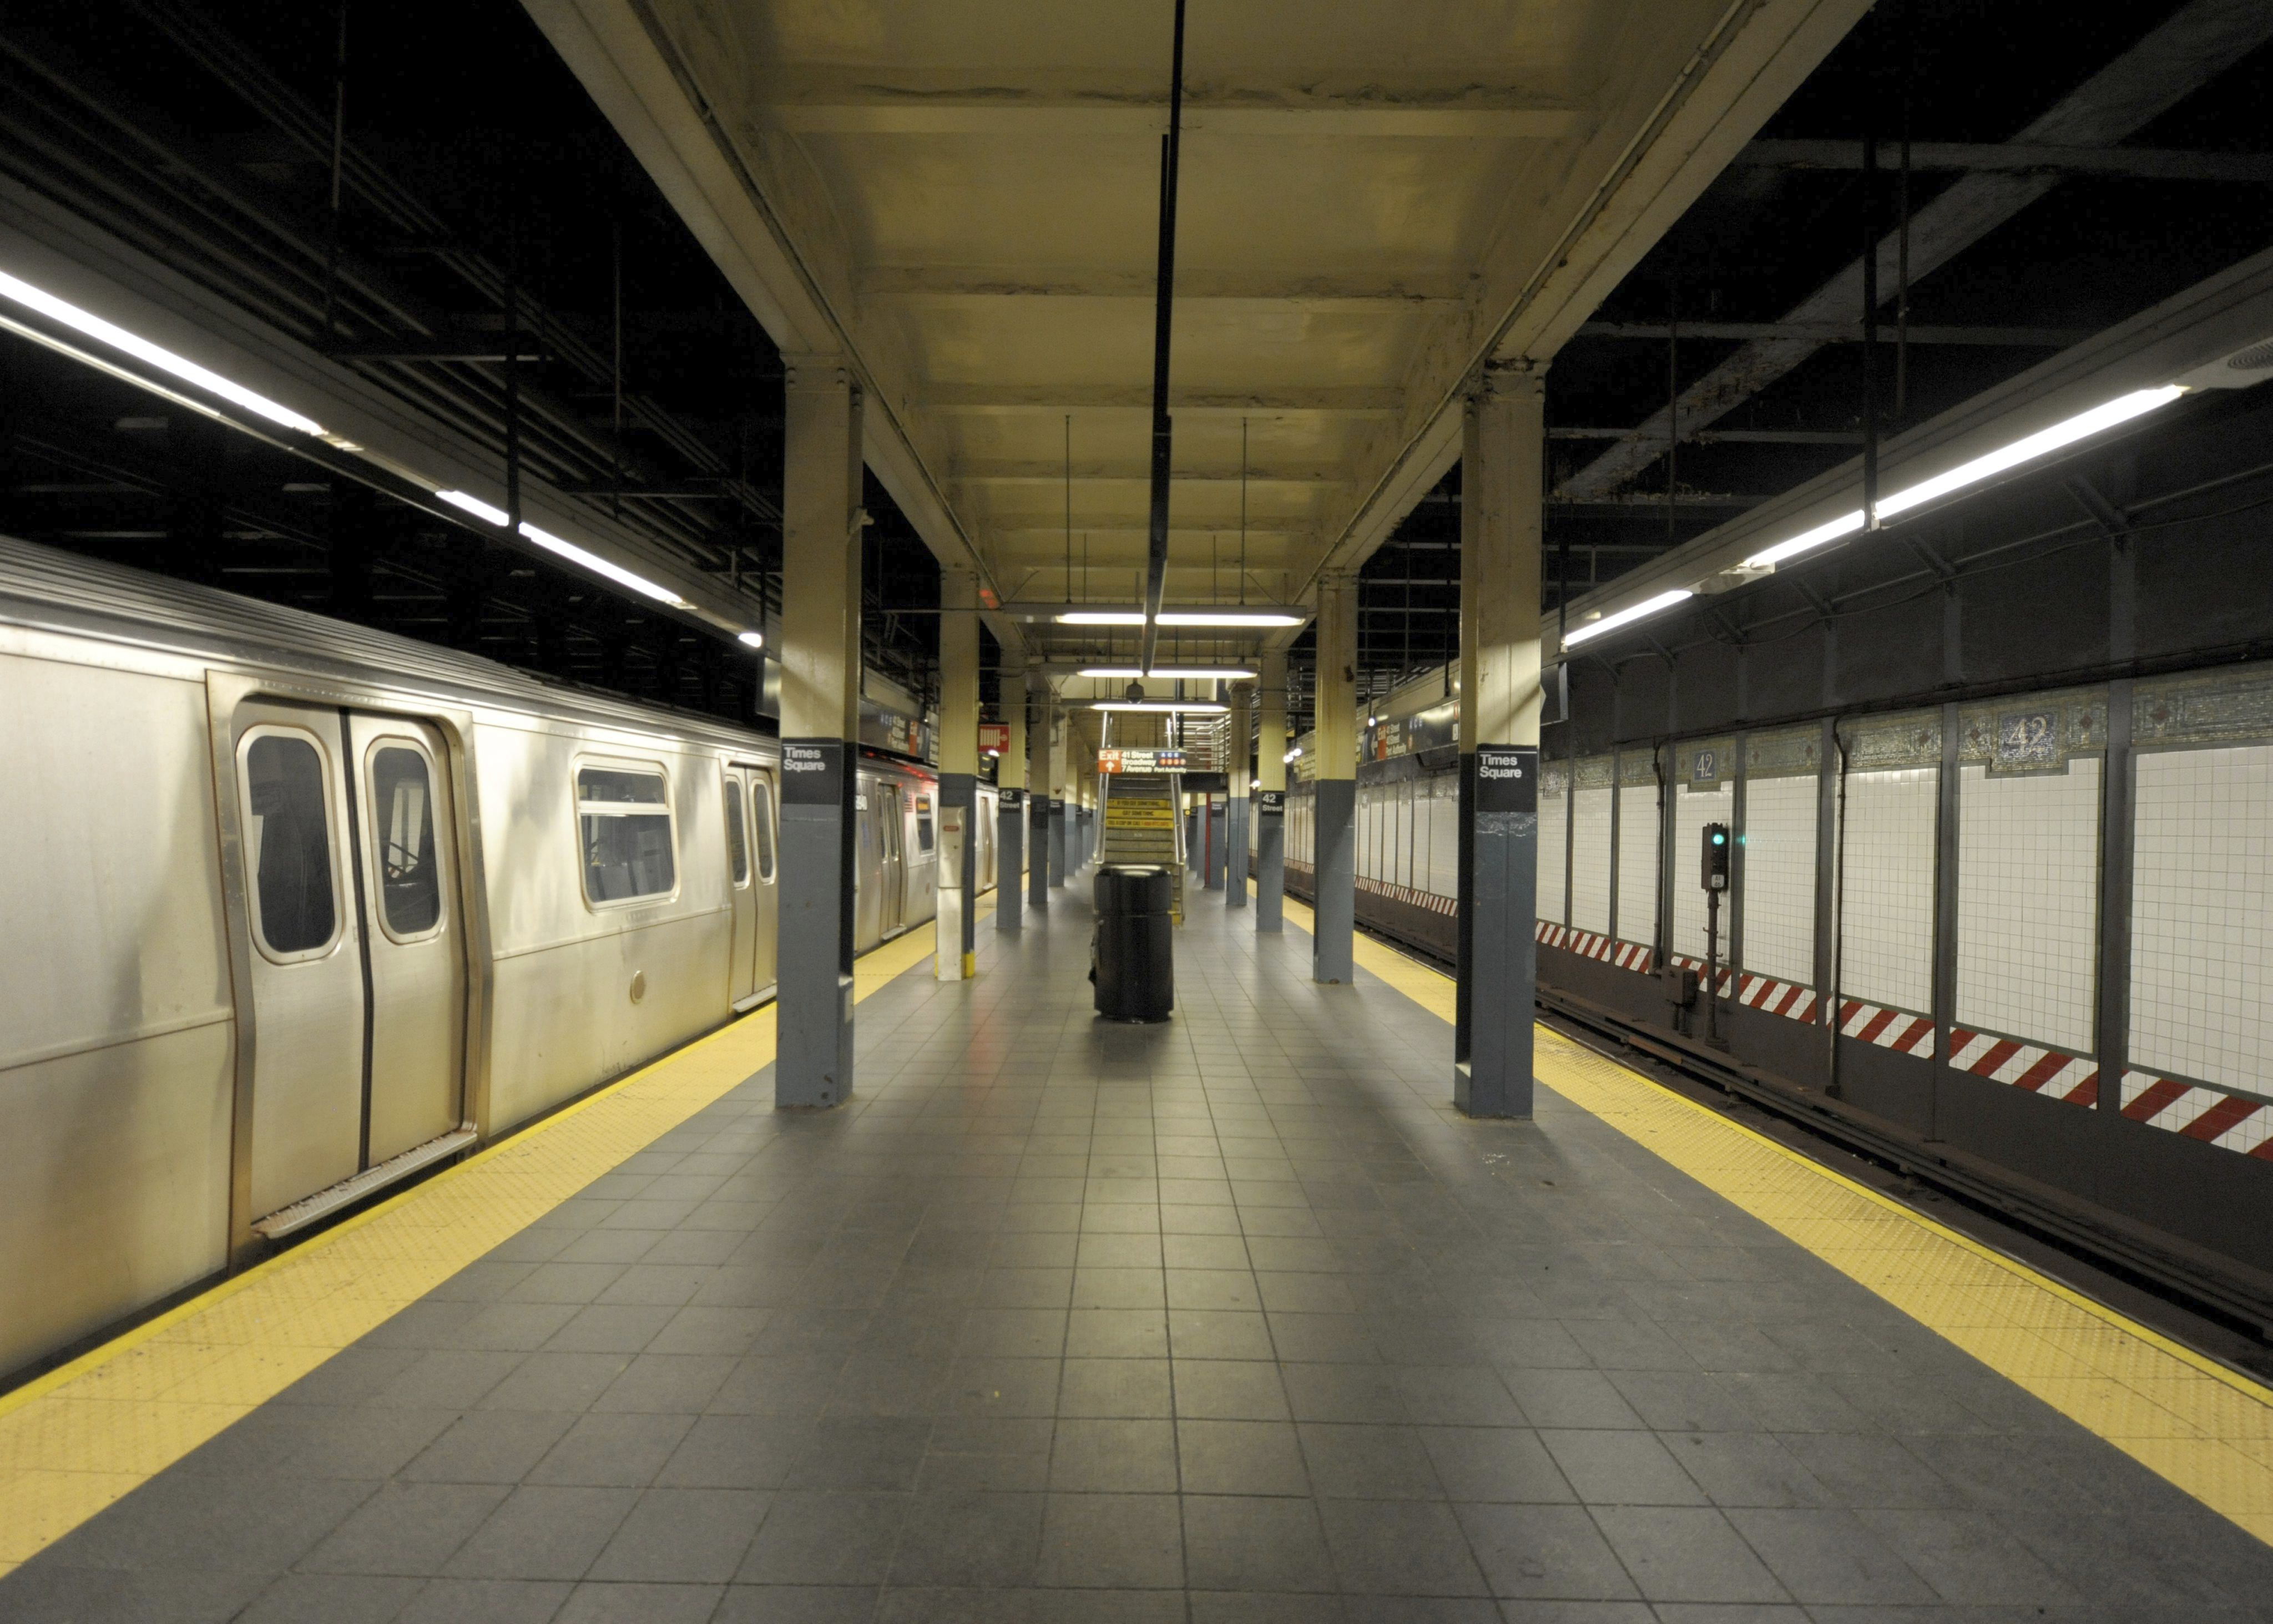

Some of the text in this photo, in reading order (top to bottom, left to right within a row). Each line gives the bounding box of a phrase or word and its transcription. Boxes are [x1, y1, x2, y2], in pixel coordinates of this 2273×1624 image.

[2006, 716, 2047, 754] 42
[784, 747, 821, 758] Times
[1099, 750, 1119, 760] Exit
[784, 758, 826, 772] Square
[1479, 754, 1518, 766] Times
[1696, 754, 1713, 777] 42
[1479, 766, 1522, 780] Square
[1000, 791, 1013, 800] 42
[1262, 794, 1276, 803] 42
